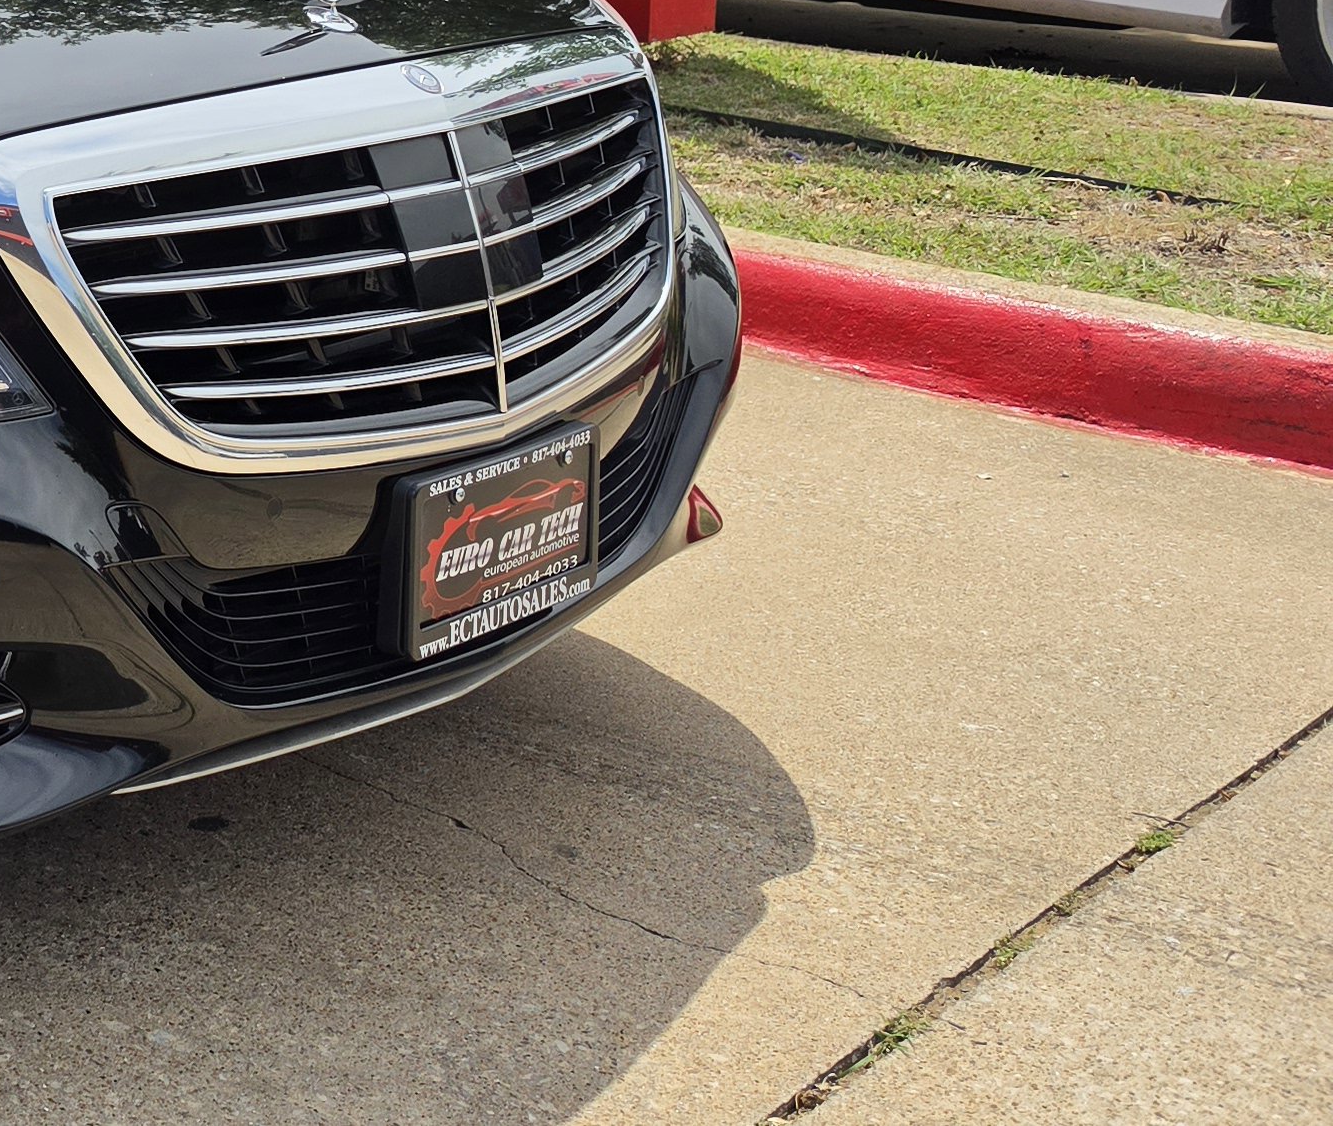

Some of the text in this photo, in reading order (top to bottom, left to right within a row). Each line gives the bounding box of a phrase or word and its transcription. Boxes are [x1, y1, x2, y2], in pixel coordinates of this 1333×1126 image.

[429, 430, 591, 497] SALES & SERVICE 817-404-4033
[436, 502, 584, 582] EURO CAR TECH
[483, 532, 580, 579] european automotive
[482, 554, 579, 604] 817-404-4033
[419, 575, 591, 660] www.ECTAUTOSALES.com
